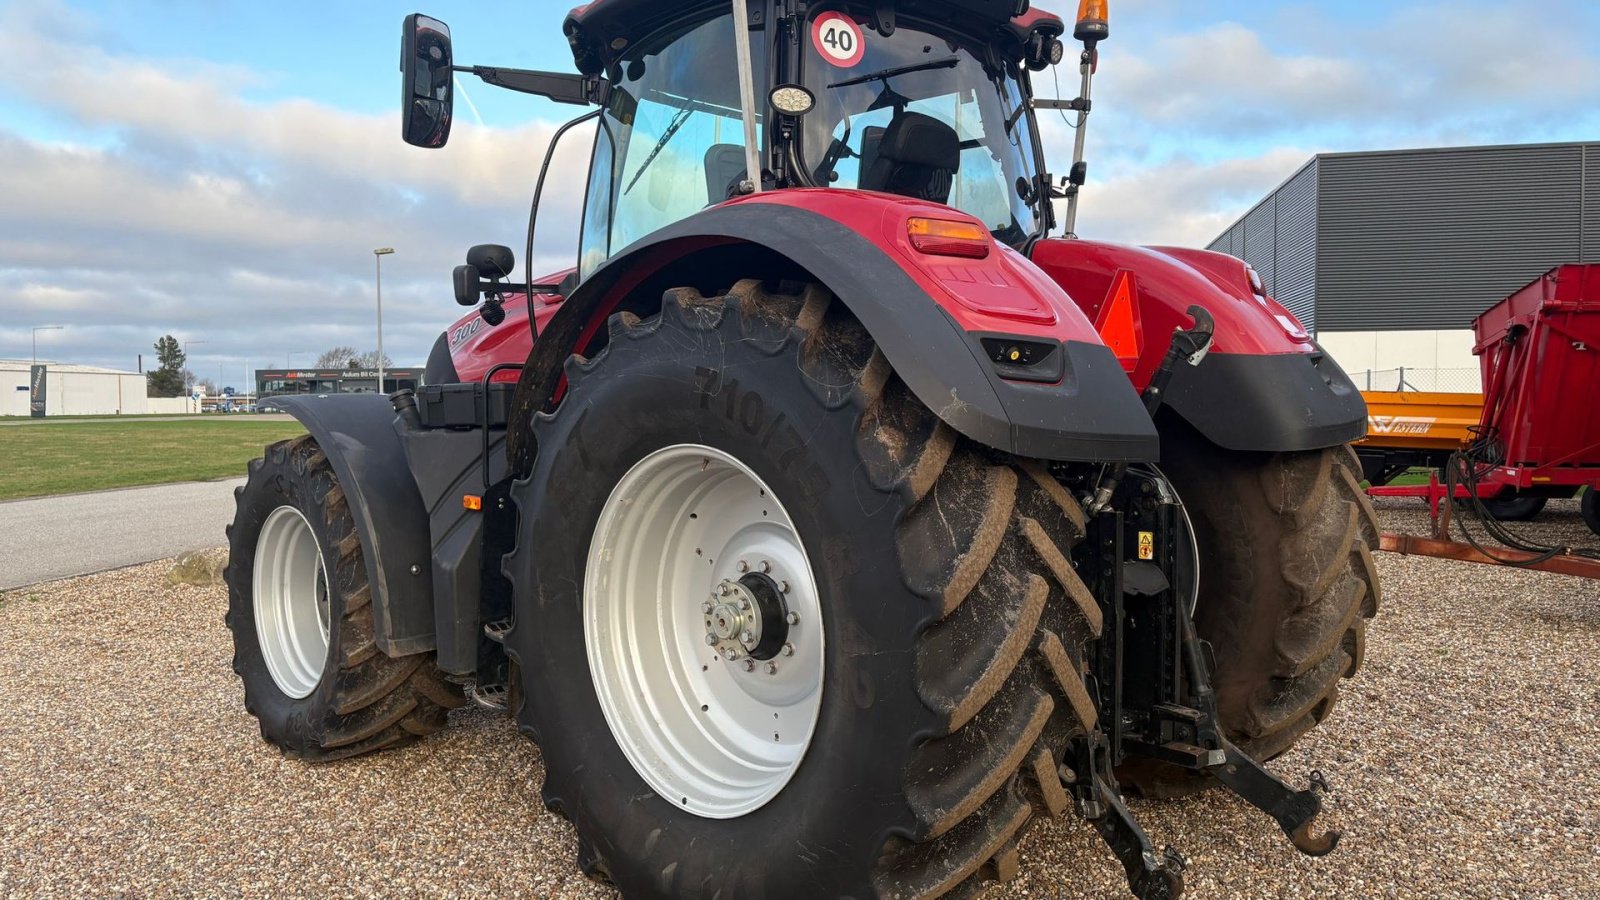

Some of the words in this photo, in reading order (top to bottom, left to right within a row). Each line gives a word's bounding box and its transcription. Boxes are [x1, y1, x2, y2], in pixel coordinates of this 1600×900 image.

[823, 27, 853, 52] 40
[451, 317, 481, 346] 300
[1368, 415, 1433, 434] WESTERN
